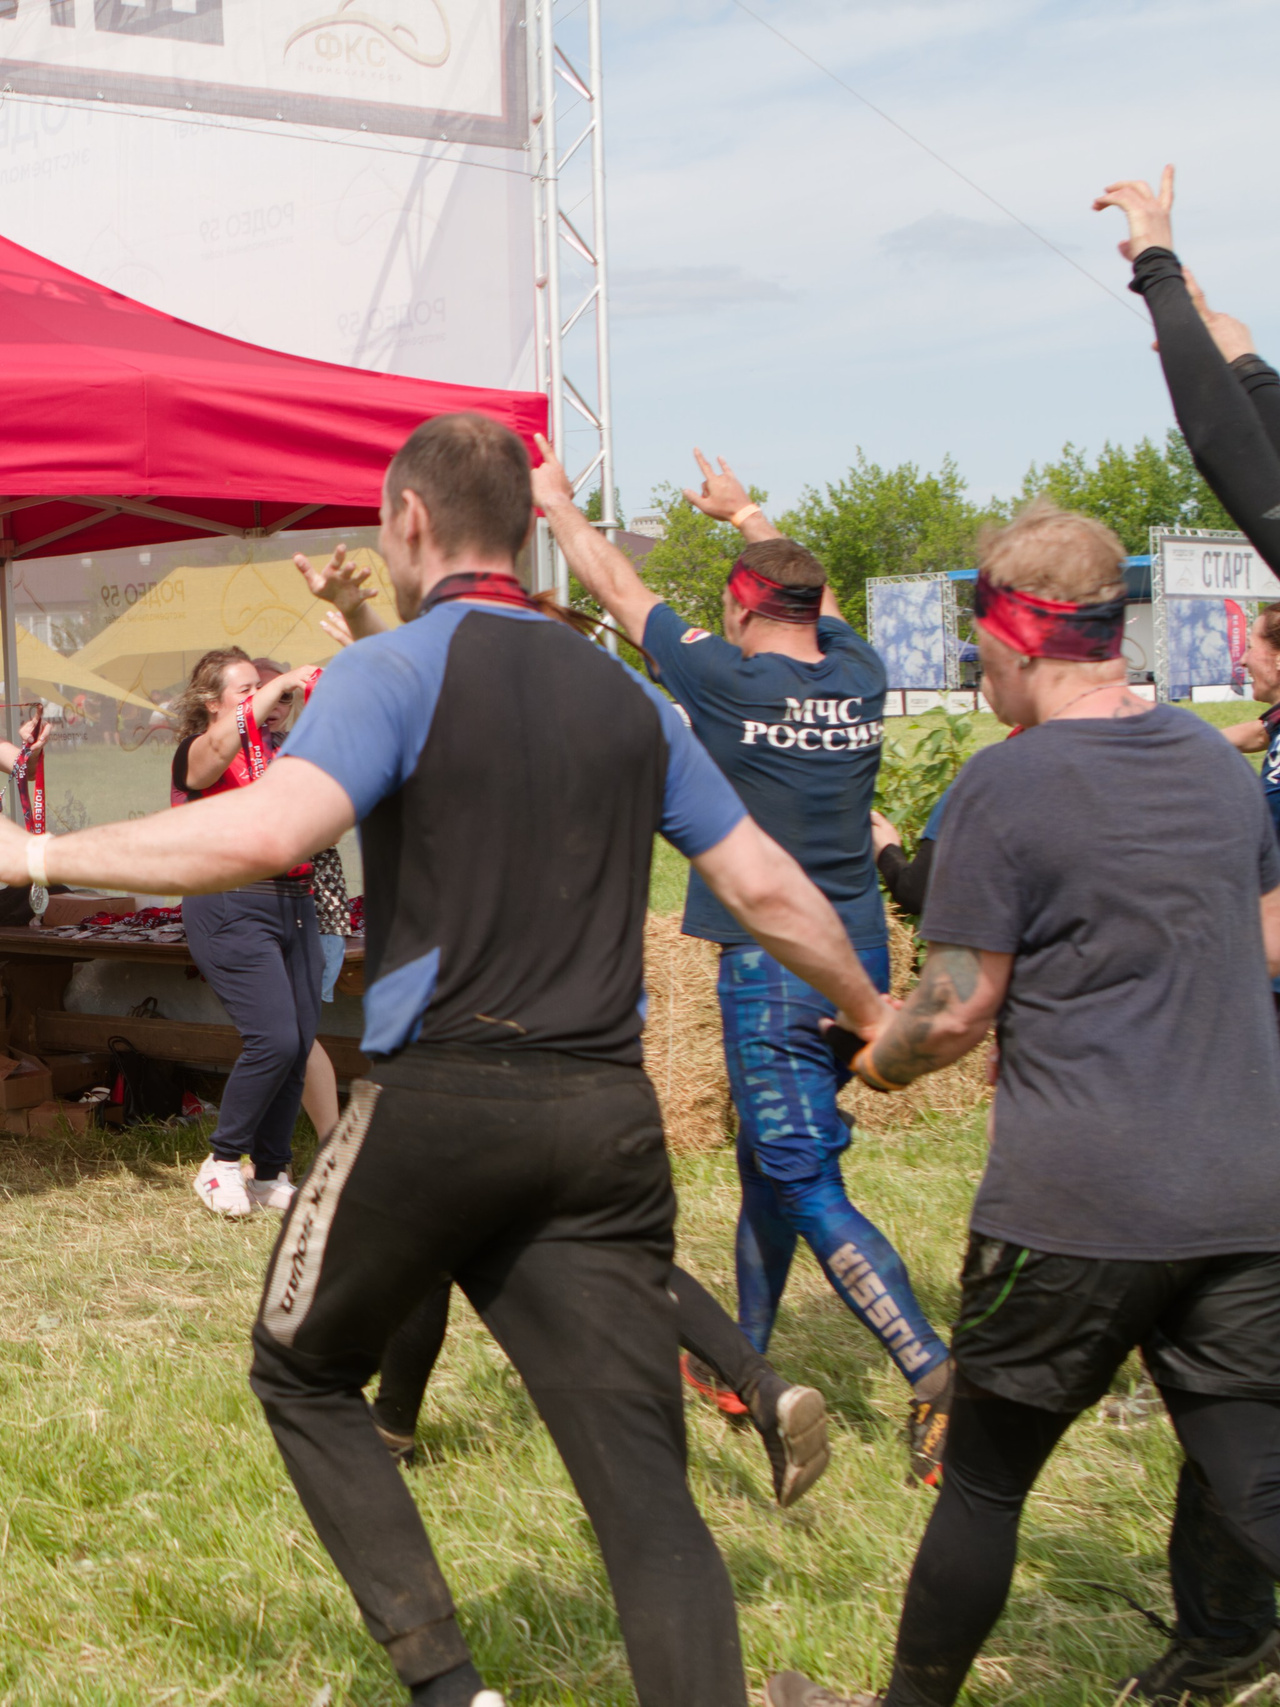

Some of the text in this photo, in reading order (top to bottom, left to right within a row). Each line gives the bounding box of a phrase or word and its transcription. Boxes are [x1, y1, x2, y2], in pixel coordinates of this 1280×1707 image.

[315, 31, 386, 68] ФКС
[1202, 551, 1253, 590] СТАРТ
[782, 697, 863, 725] МЧС
[34, 789, 43, 821] РОДЕО
[827, 1242, 932, 1373] RUSSIA
